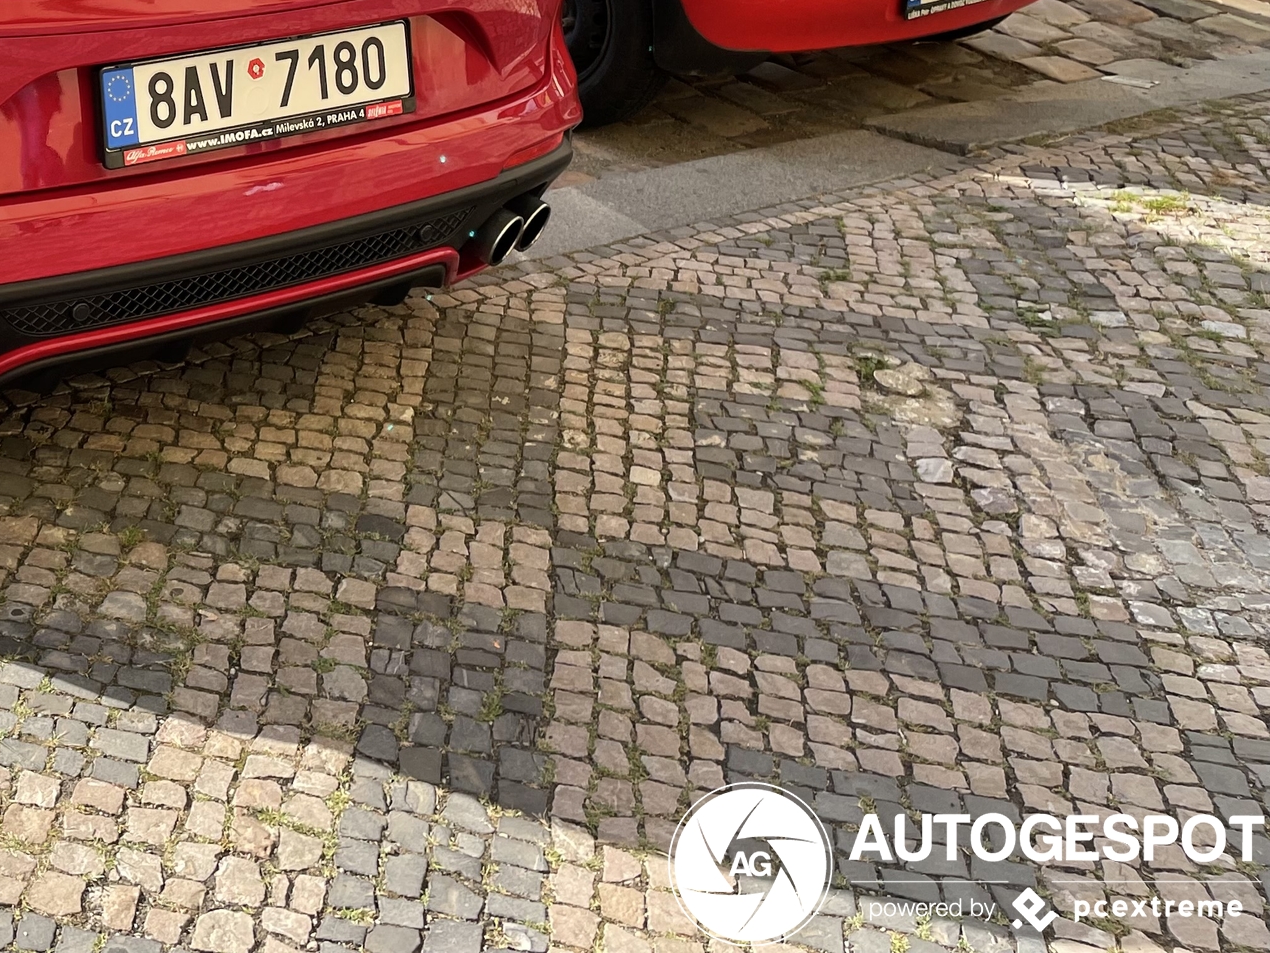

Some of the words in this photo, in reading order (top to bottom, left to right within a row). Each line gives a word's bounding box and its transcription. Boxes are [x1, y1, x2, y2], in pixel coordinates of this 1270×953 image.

[147, 59, 234, 129] 8AV
[275, 36, 386, 108] 7180
[110, 118, 135, 138] CZ
[275, 118, 314, 134] Milevská
[316, 118, 325, 128] 2,
[327, 110, 358, 125] PRAHA
[358, 108, 365, 118] 4
[186, 127, 274, 151] www.IMOFA.cz
